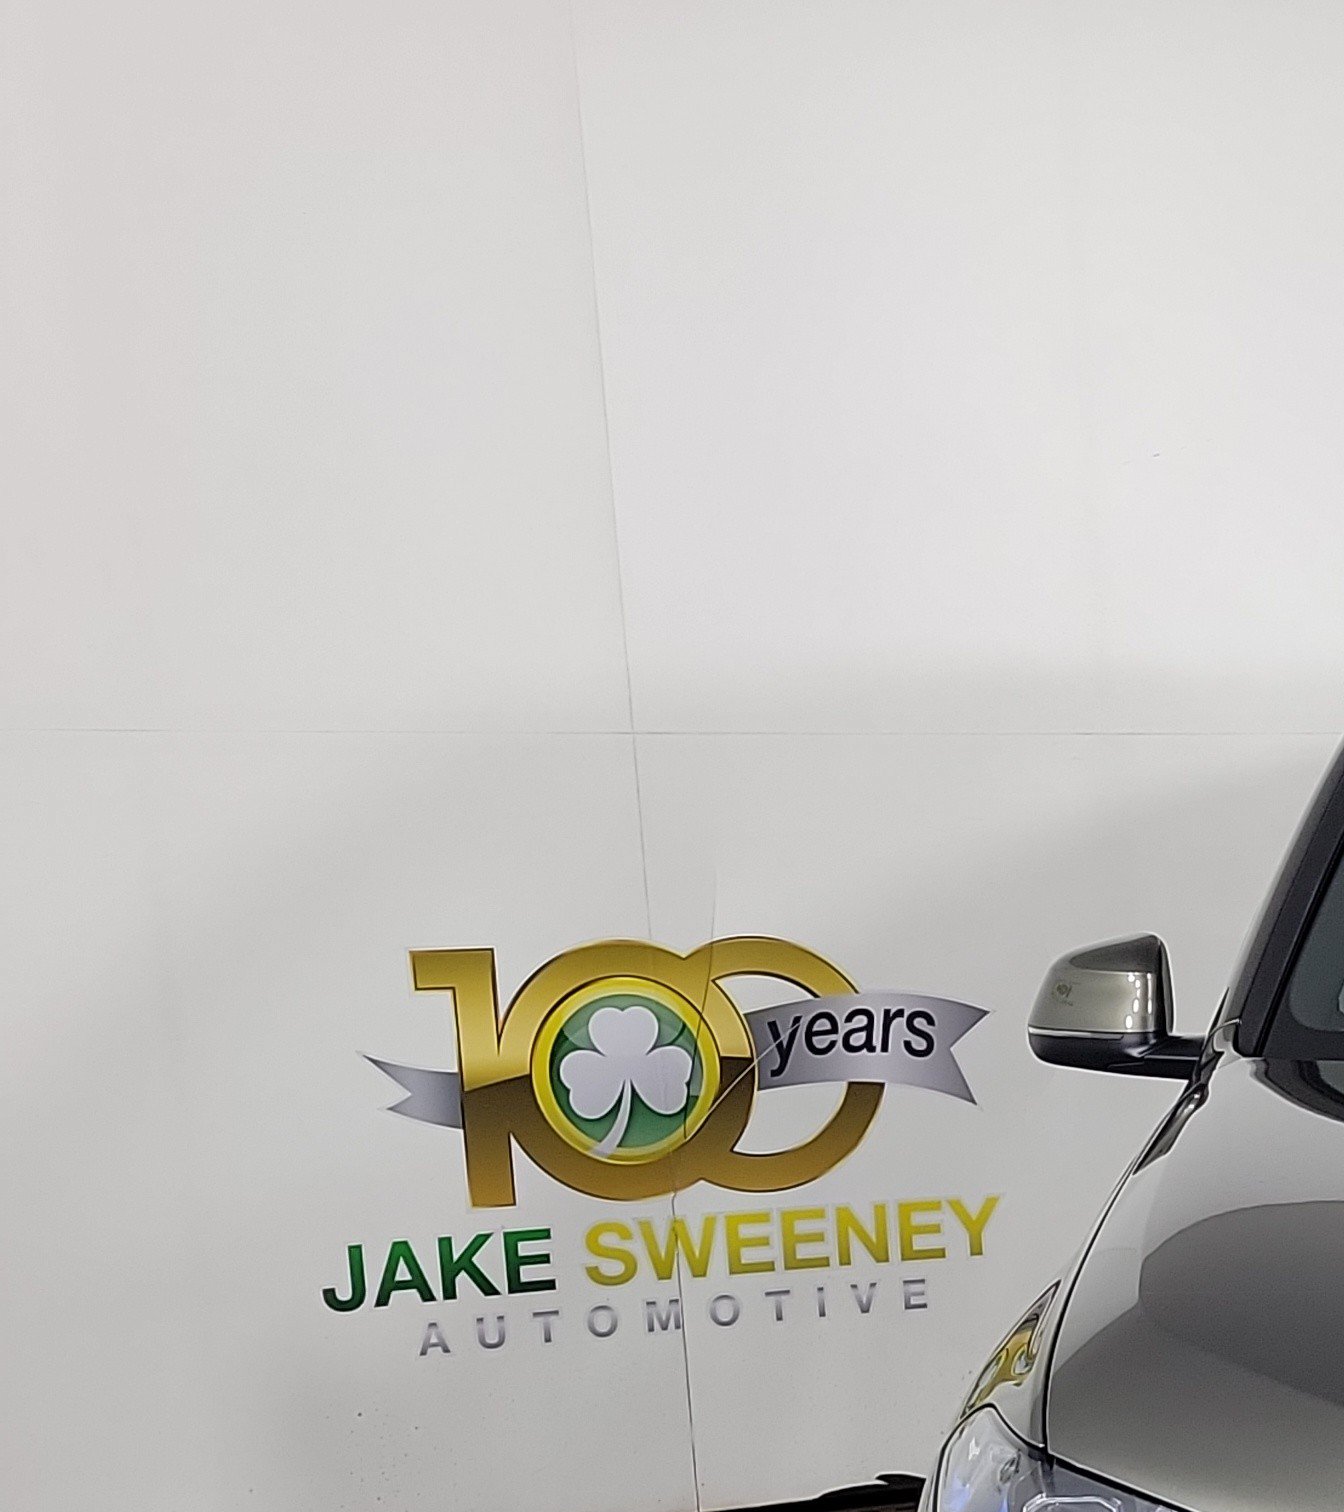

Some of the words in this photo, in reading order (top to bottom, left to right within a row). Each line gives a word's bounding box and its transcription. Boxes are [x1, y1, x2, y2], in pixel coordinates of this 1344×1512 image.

[409, 936, 886, 1207] 100
[767, 1006, 936, 1078] years
[322, 1228, 556, 1312] JAKE
[584, 1195, 1000, 1286] SWEENEY
[419, 1278, 928, 1356] AUTOMOTIVE
